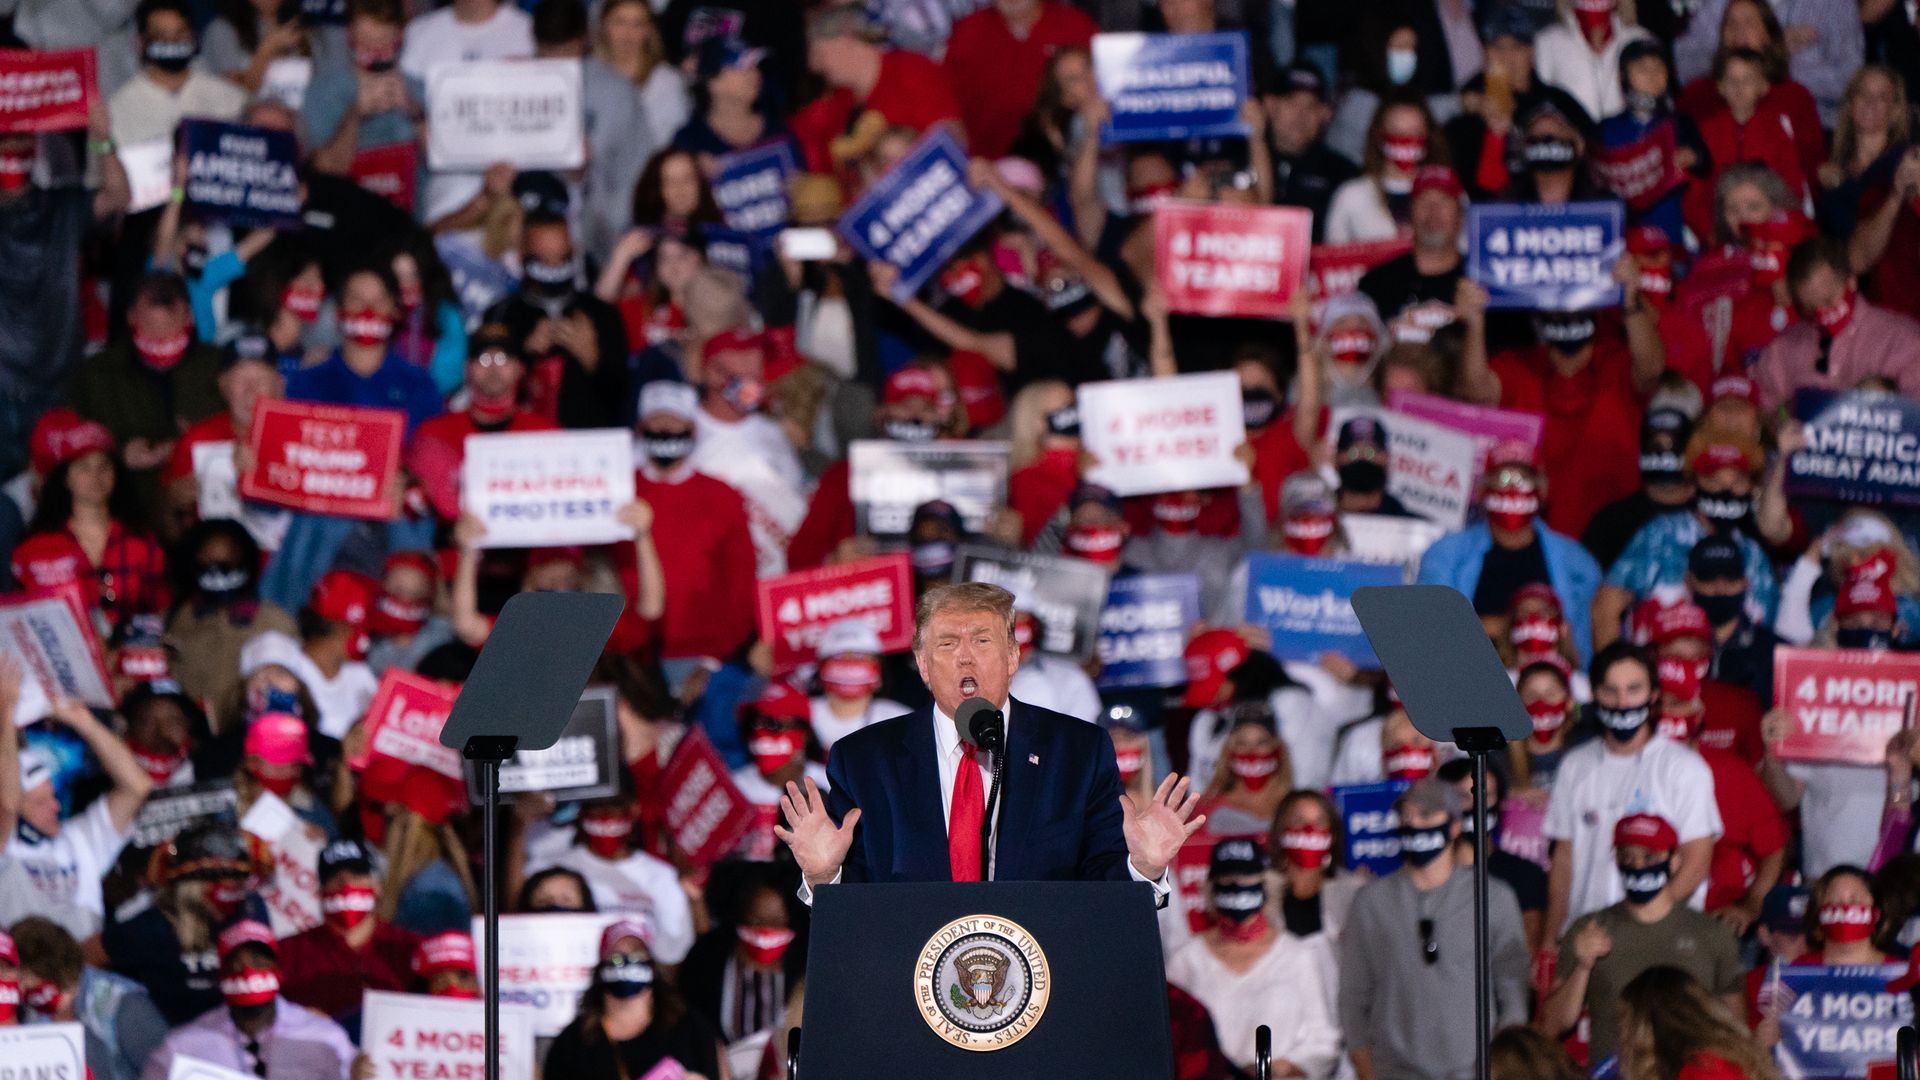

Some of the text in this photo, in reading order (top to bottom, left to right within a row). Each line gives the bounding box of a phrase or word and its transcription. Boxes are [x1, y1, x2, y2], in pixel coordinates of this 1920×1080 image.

[1170, 230, 1284, 262] 4 MORE
[1486, 225, 1604, 256] 4 MORE
[1170, 259, 1281, 292] YEARS!
[1488, 256, 1604, 286] YEARS!
[1838, 403, 1902, 433] MAKE
[1802, 424, 1920, 463] AMERIC
[1792, 451, 1864, 481] GREAT
[777, 577, 894, 624] 4 MORE
[1795, 676, 1817, 704] 4
[920, 920, 1046, 1044] SEAL OF THE PRESIDENT OF THE UNITED STATES
[1791, 992, 1914, 1020] 4 MORE
[388, 1028, 404, 1048] 4
